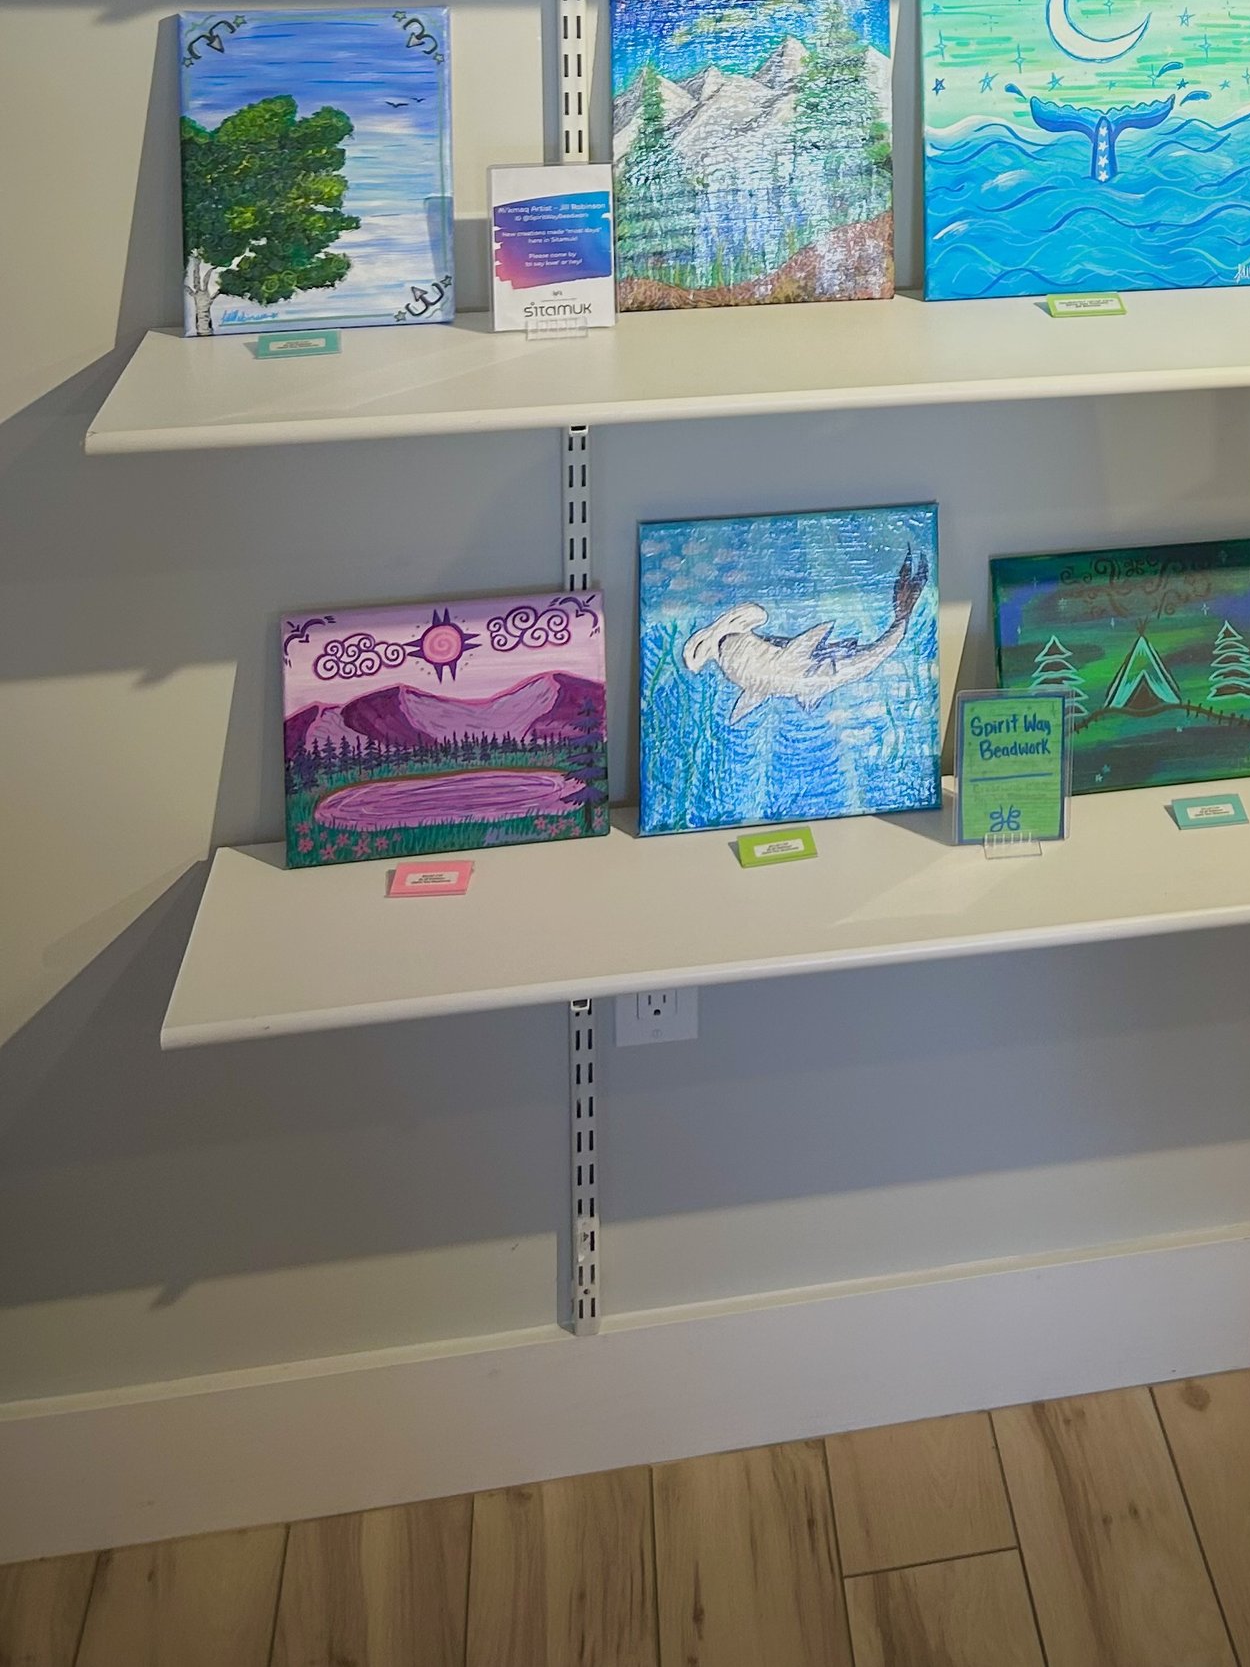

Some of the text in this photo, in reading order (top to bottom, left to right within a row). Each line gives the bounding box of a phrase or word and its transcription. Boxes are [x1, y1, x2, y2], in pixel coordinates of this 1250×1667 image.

[970, 712, 1051, 737] Spirit Way
[979, 739, 1051, 761] Beadwork
